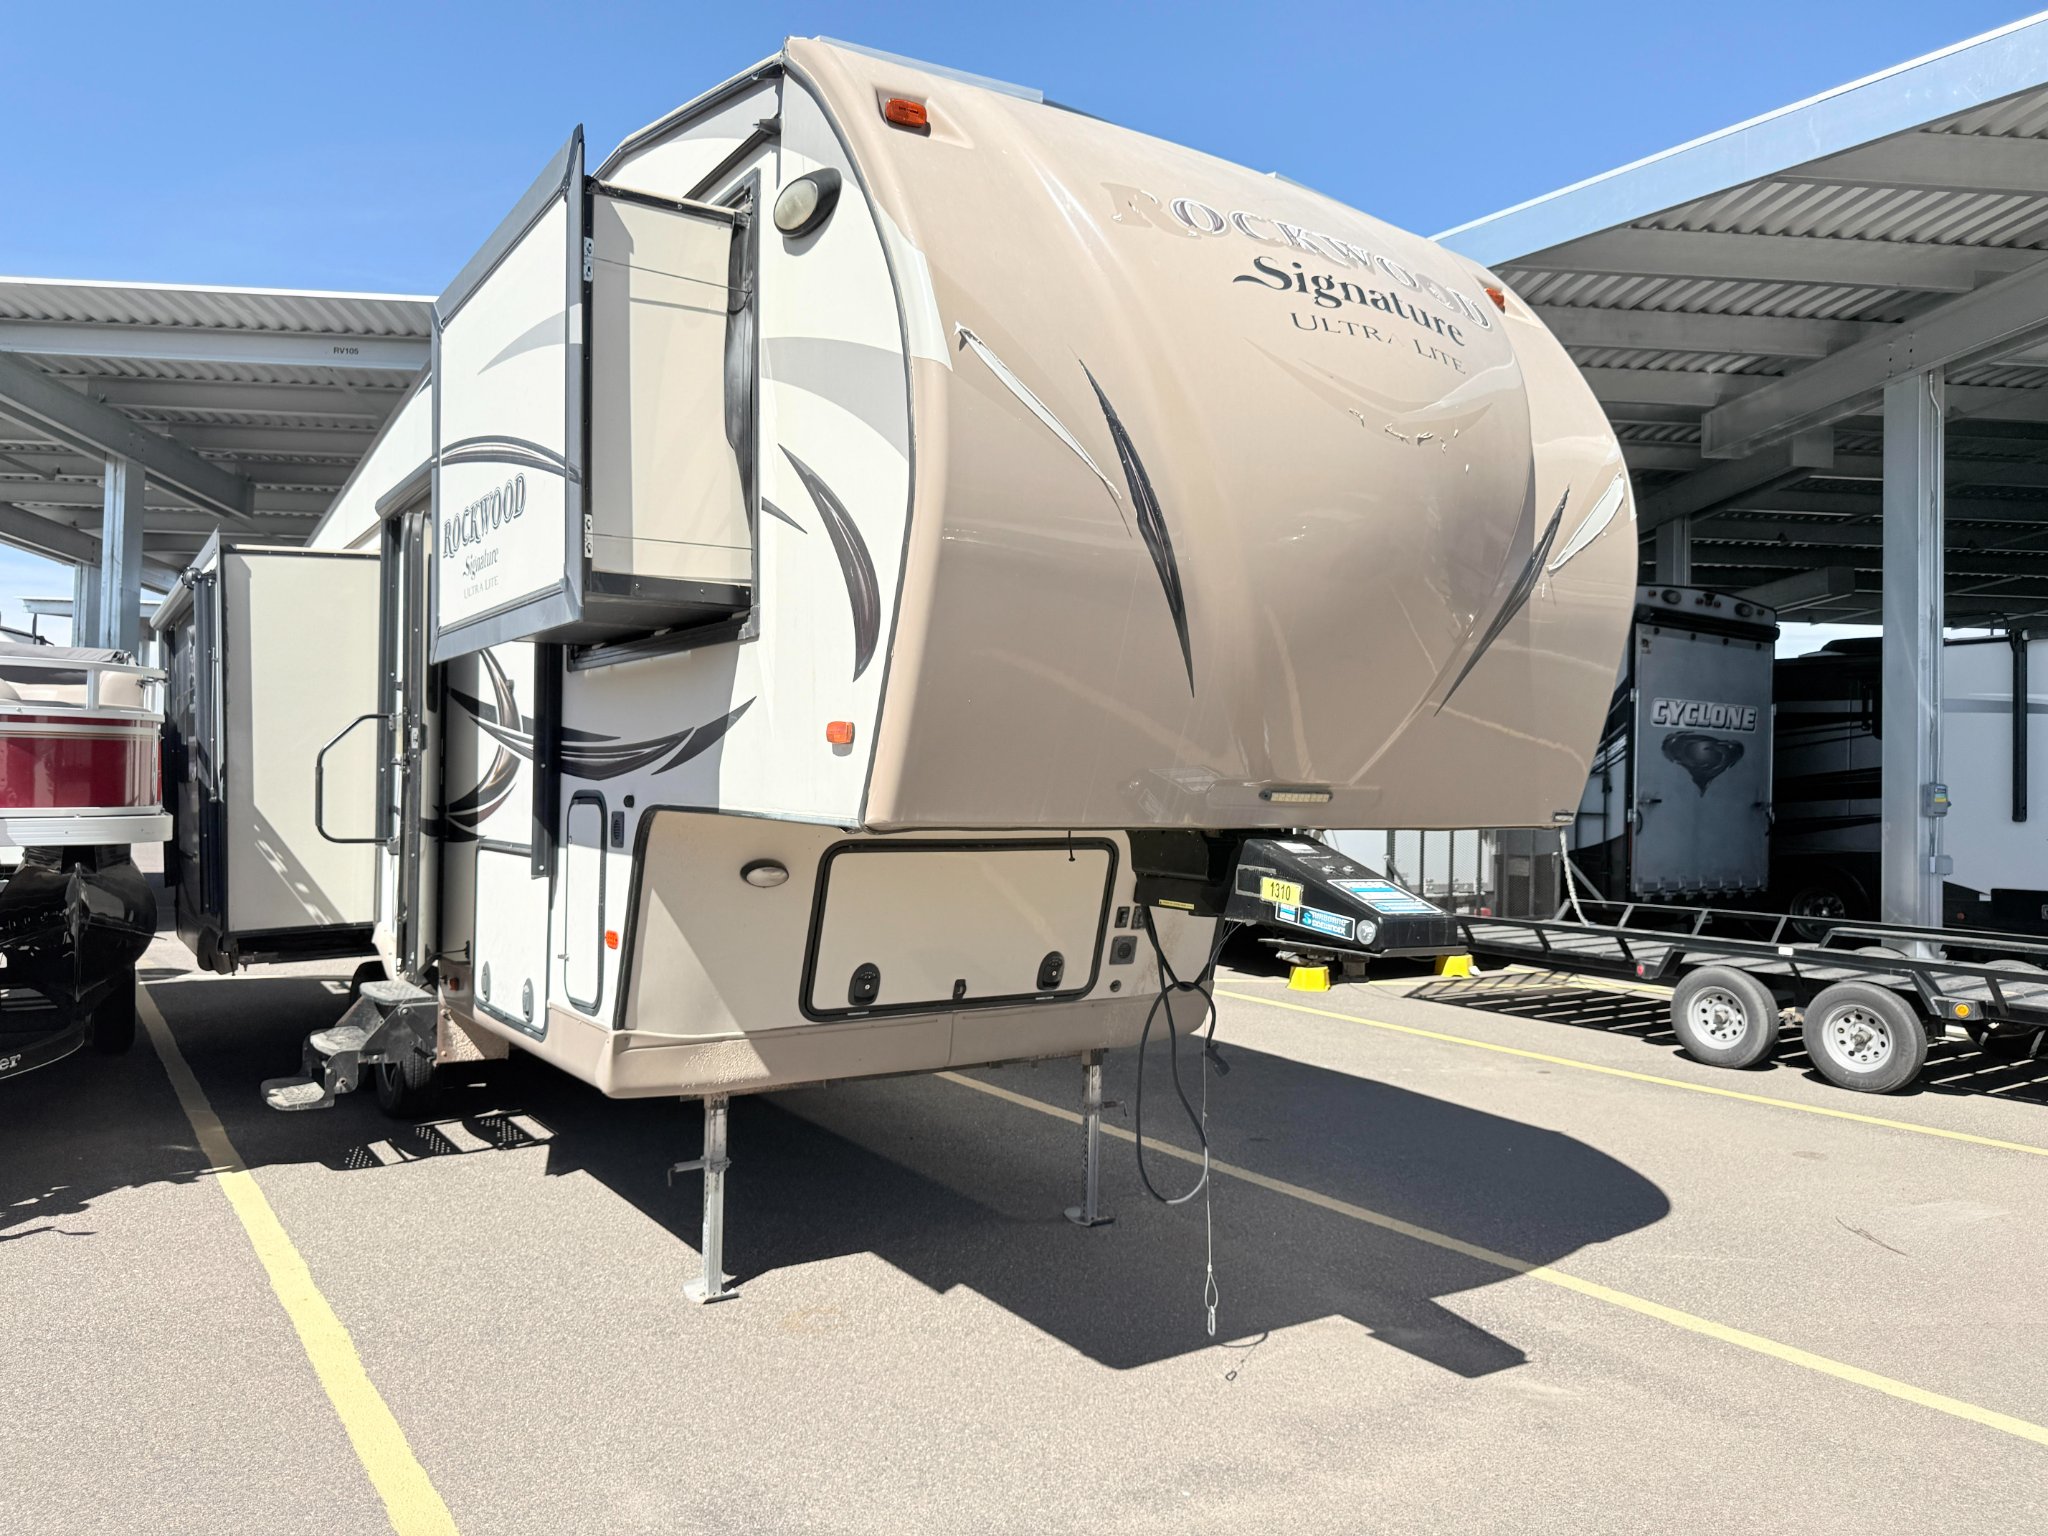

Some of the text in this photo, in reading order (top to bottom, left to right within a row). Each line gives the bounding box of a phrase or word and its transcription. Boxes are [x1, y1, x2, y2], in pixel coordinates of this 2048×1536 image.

[1100, 183, 1491, 332] ROCKWOOD
[1233, 256, 1466, 347] Signature
[333, 346, 359, 355] RV105
[1413, 338, 1466, 375] LITE
[443, 472, 527, 559] ROCKWOOD
[463, 548, 499, 580] Signature
[1652, 700, 1757, 731] CYCLONE
[1270, 881, 1291, 901] 1310
